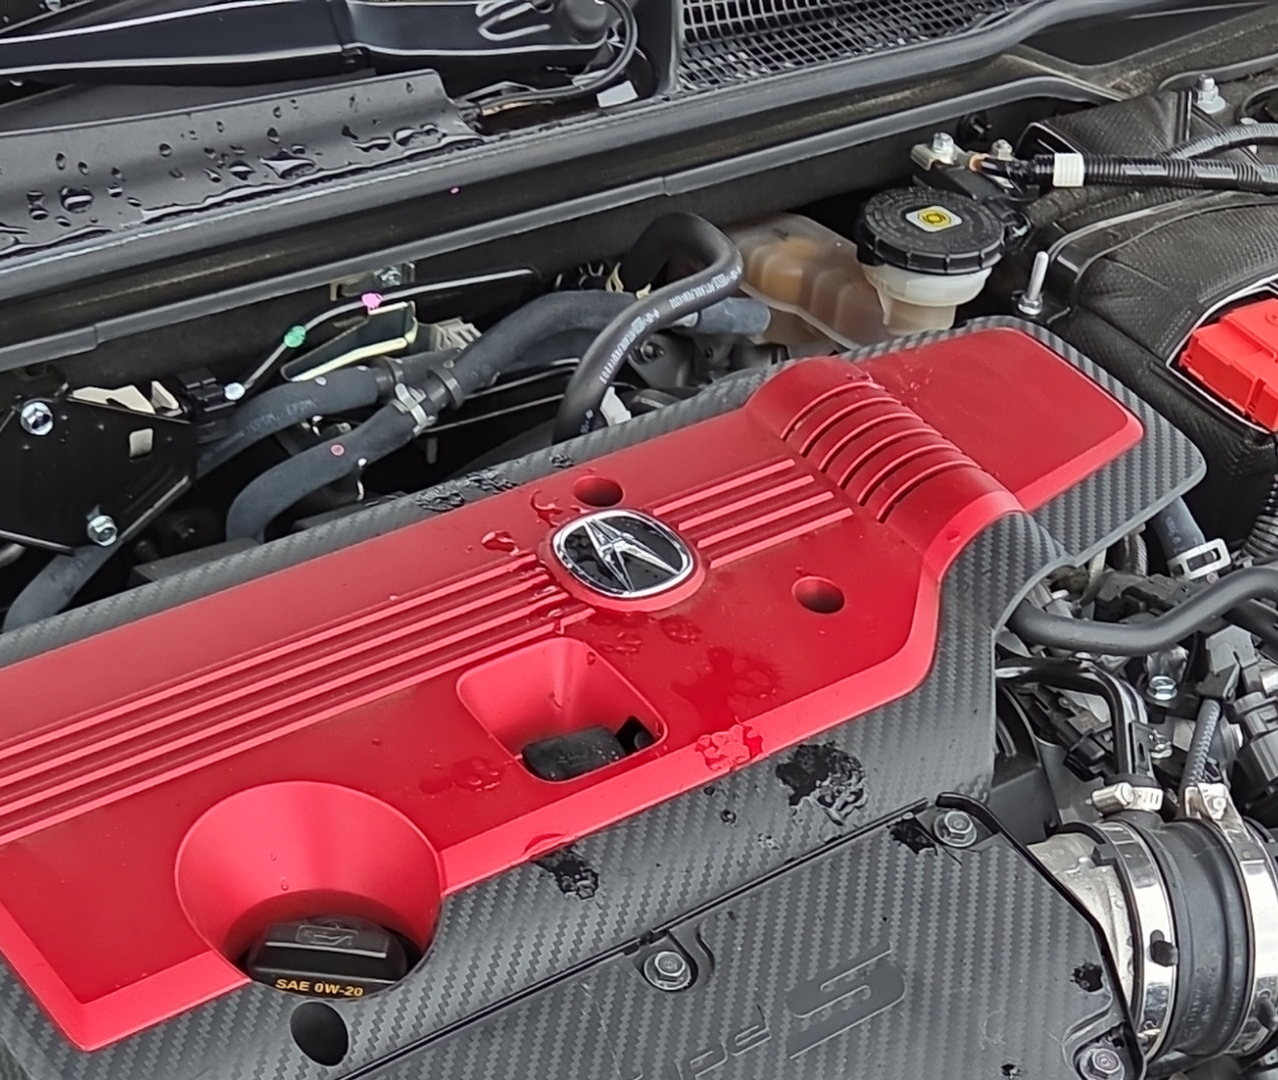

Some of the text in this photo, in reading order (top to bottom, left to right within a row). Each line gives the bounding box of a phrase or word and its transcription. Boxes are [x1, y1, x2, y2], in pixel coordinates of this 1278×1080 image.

[275, 978, 363, 997] SAE 0W-20
[785, 942, 907, 1060] S
